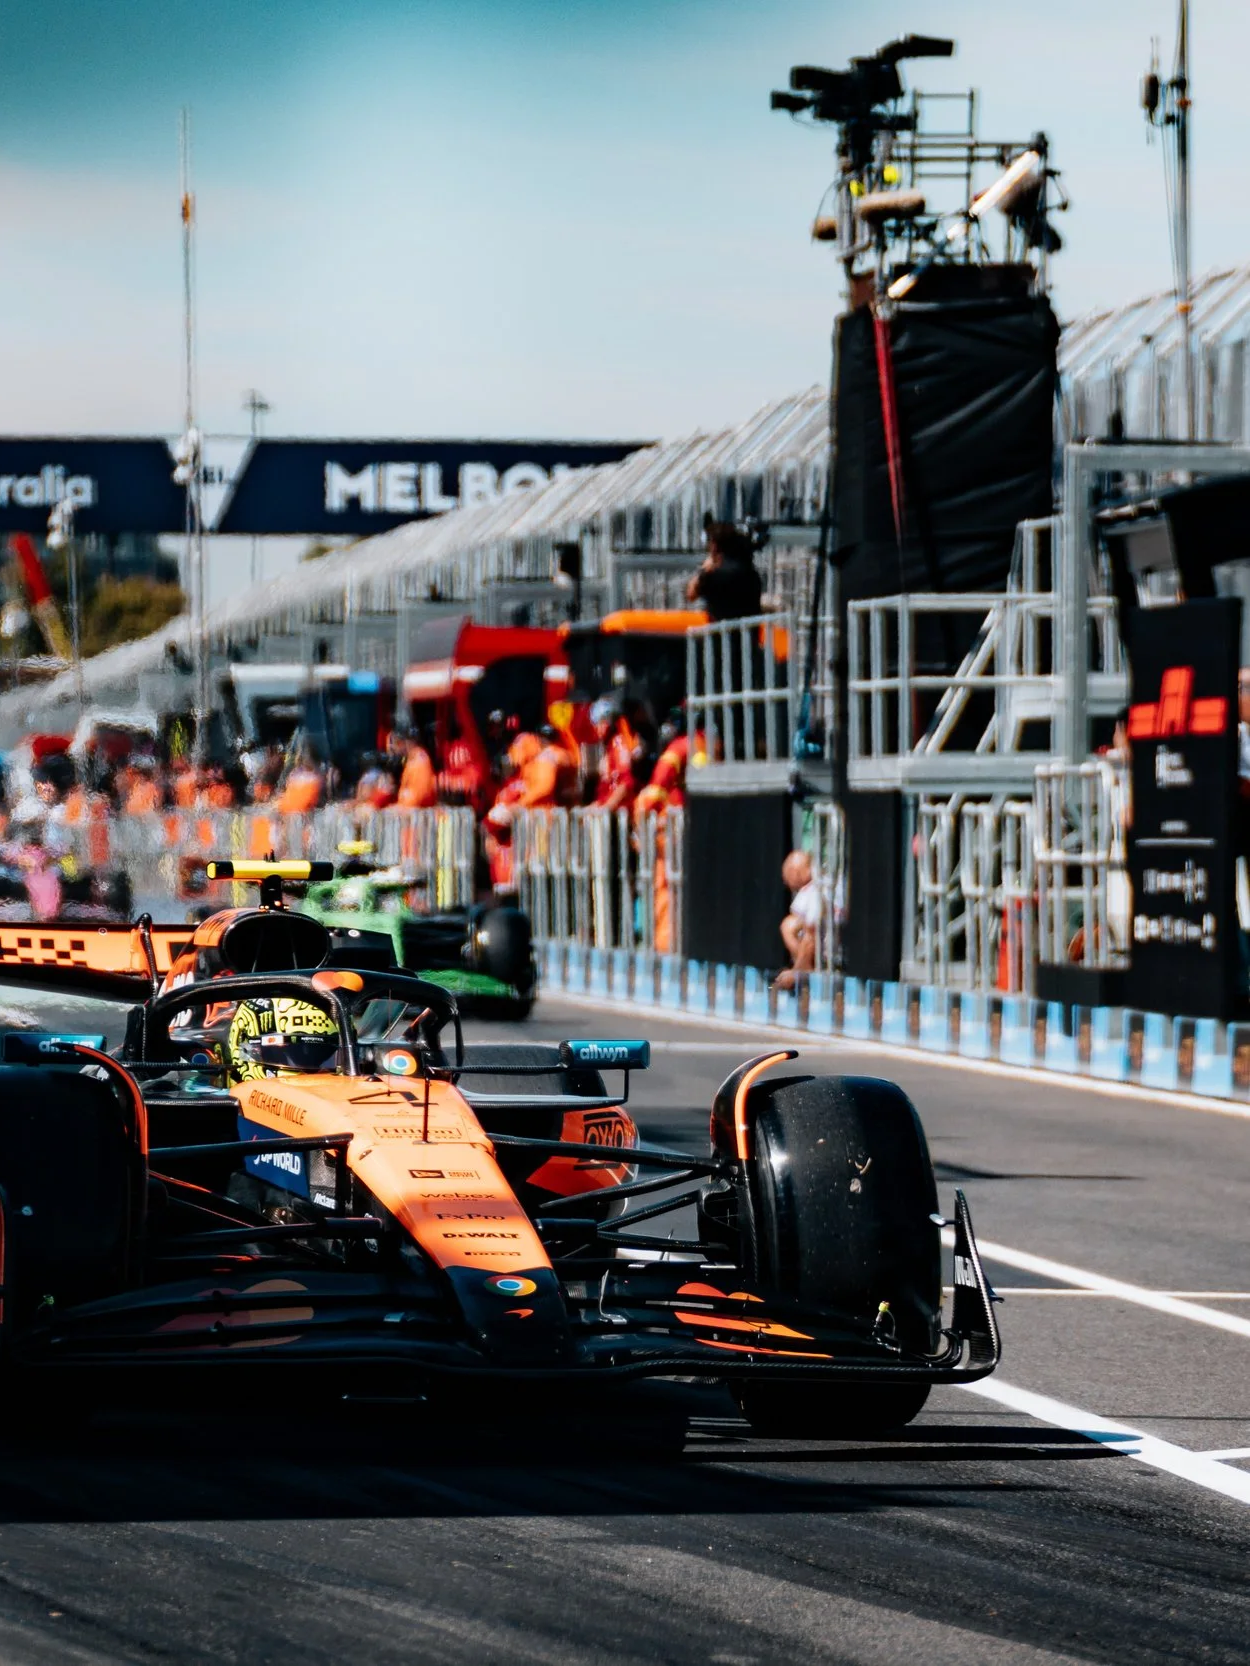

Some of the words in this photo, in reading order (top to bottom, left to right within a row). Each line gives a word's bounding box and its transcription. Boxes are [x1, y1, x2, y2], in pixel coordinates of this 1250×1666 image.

[324, 460, 572, 514] MELBO
[292, 1015, 330, 1027] OKX
[579, 1044, 629, 1061] allwyn
[248, 1089, 283, 1117] RICHARD
[283, 1102, 308, 1126] MILLE
[273, 1152, 302, 1176] WORLD
